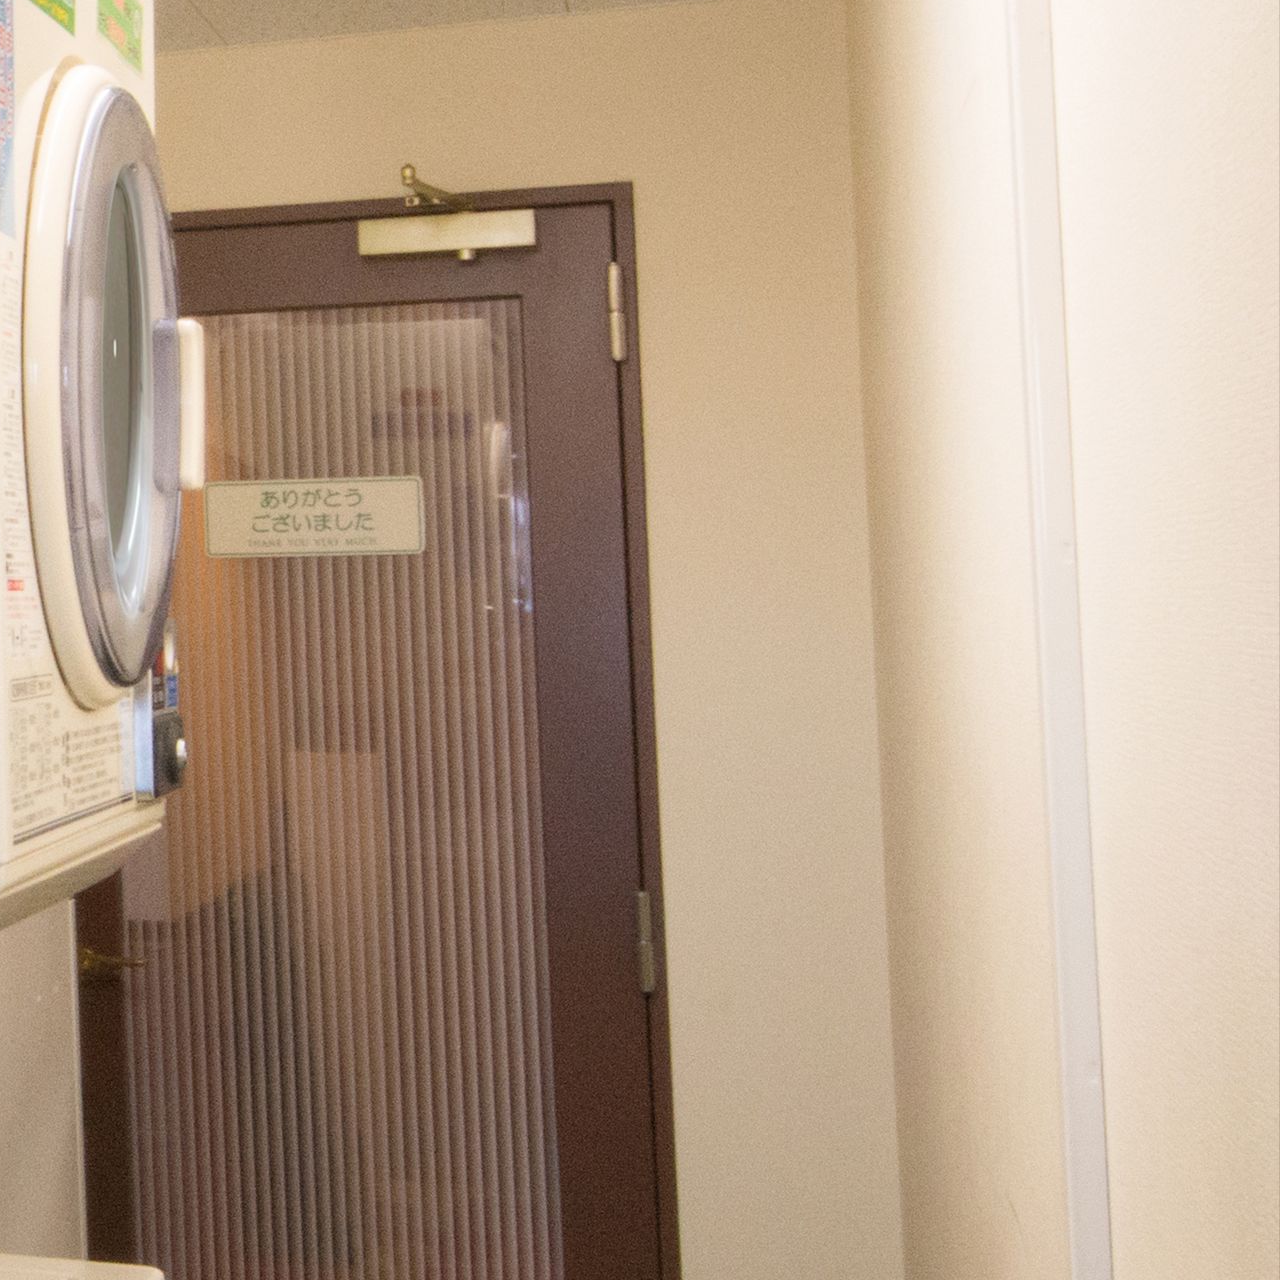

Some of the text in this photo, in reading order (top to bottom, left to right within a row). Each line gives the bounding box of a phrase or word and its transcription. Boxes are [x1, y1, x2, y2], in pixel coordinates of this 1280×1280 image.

[260, 488, 362, 509] ありがとう
[252, 513, 375, 533] ございました
